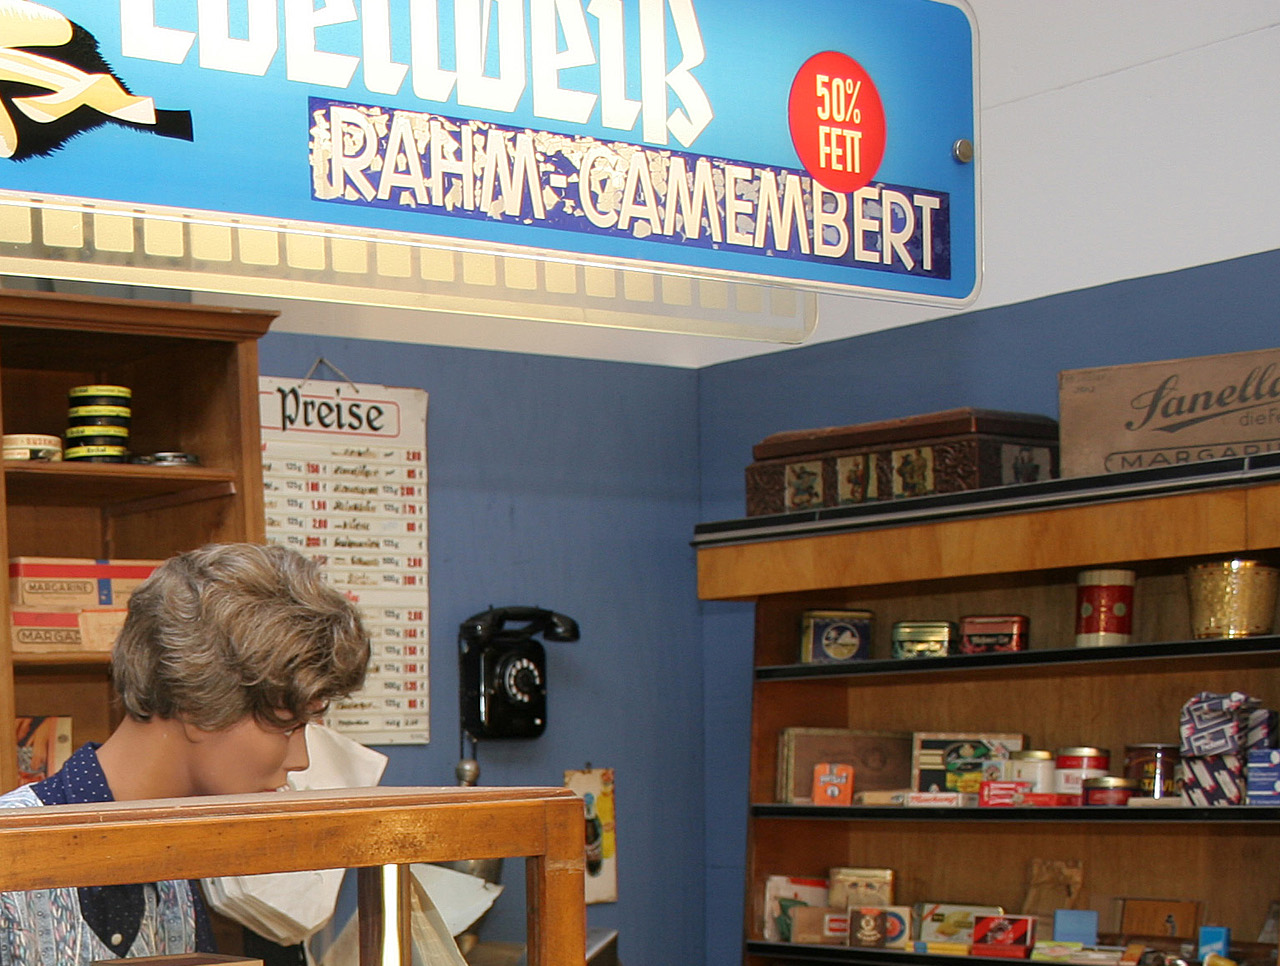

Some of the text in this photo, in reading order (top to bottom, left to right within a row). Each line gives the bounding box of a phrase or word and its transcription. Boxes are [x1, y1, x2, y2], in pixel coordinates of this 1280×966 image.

[815, 73, 862, 124] 50%
[818, 125, 863, 174] FETT
[276, 386, 385, 432] Preise
[28, 581, 89, 592] MARGARINE
